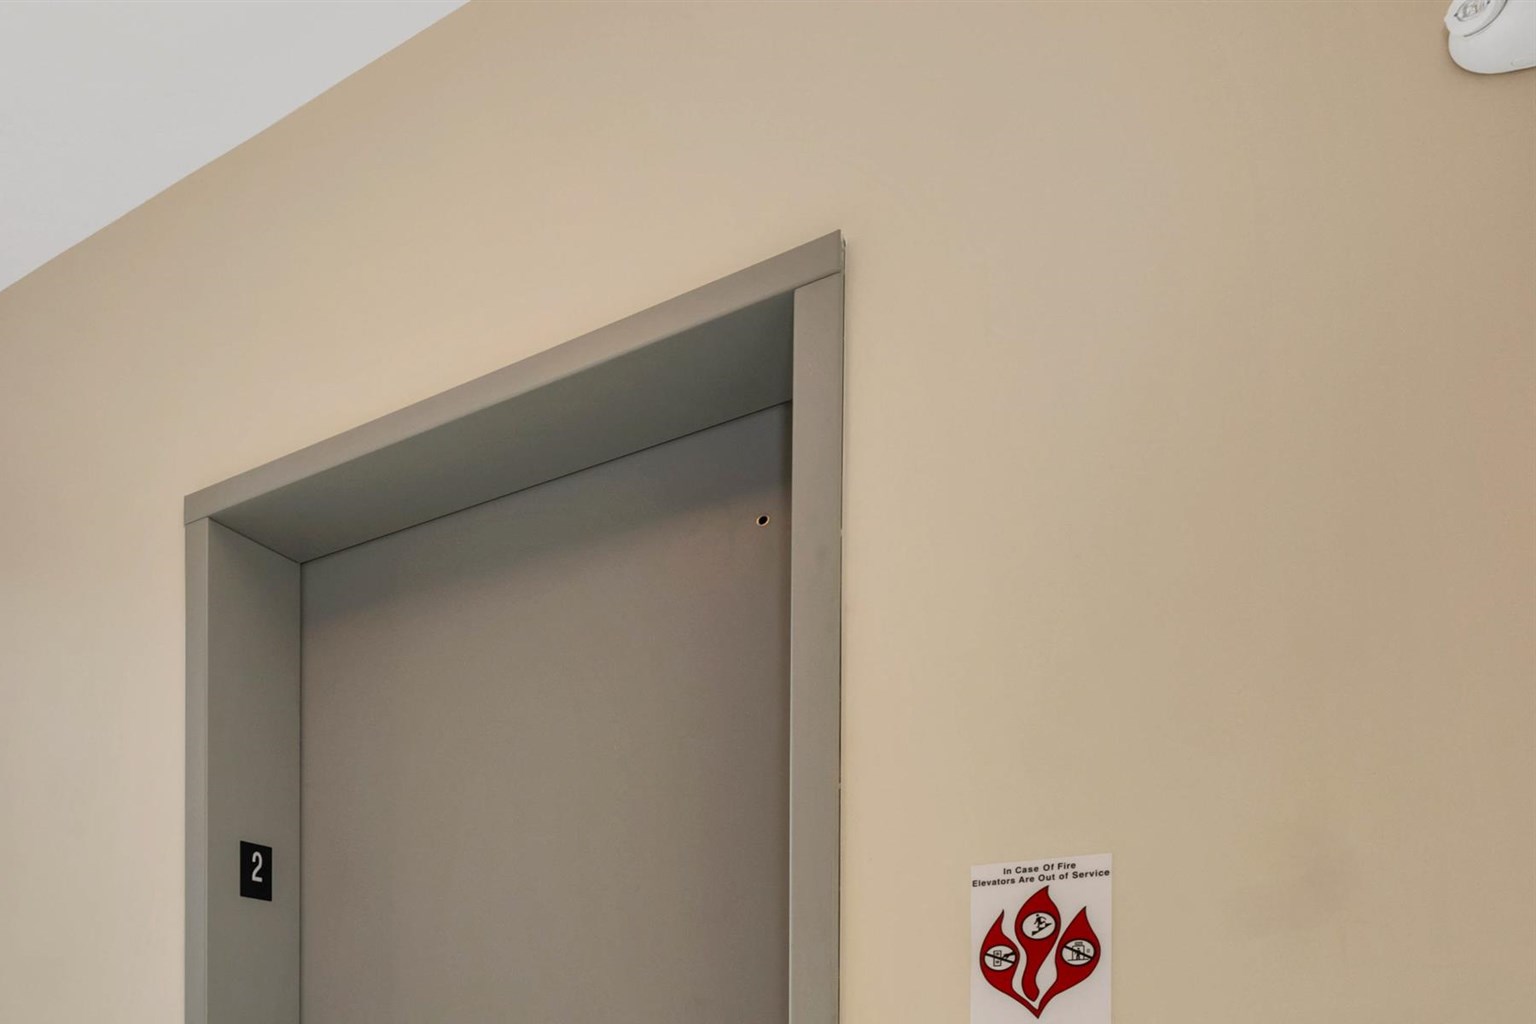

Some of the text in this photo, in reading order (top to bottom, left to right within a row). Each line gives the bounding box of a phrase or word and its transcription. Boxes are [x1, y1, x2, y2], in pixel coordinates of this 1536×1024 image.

[251, 851, 263, 883] 2
[1015, 866, 1039, 874] Case
[1043, 863, 1054, 872] Of
[1058, 862, 1076, 870] Fire
[972, 869, 1110, 887] Elevators Are Out of Service
